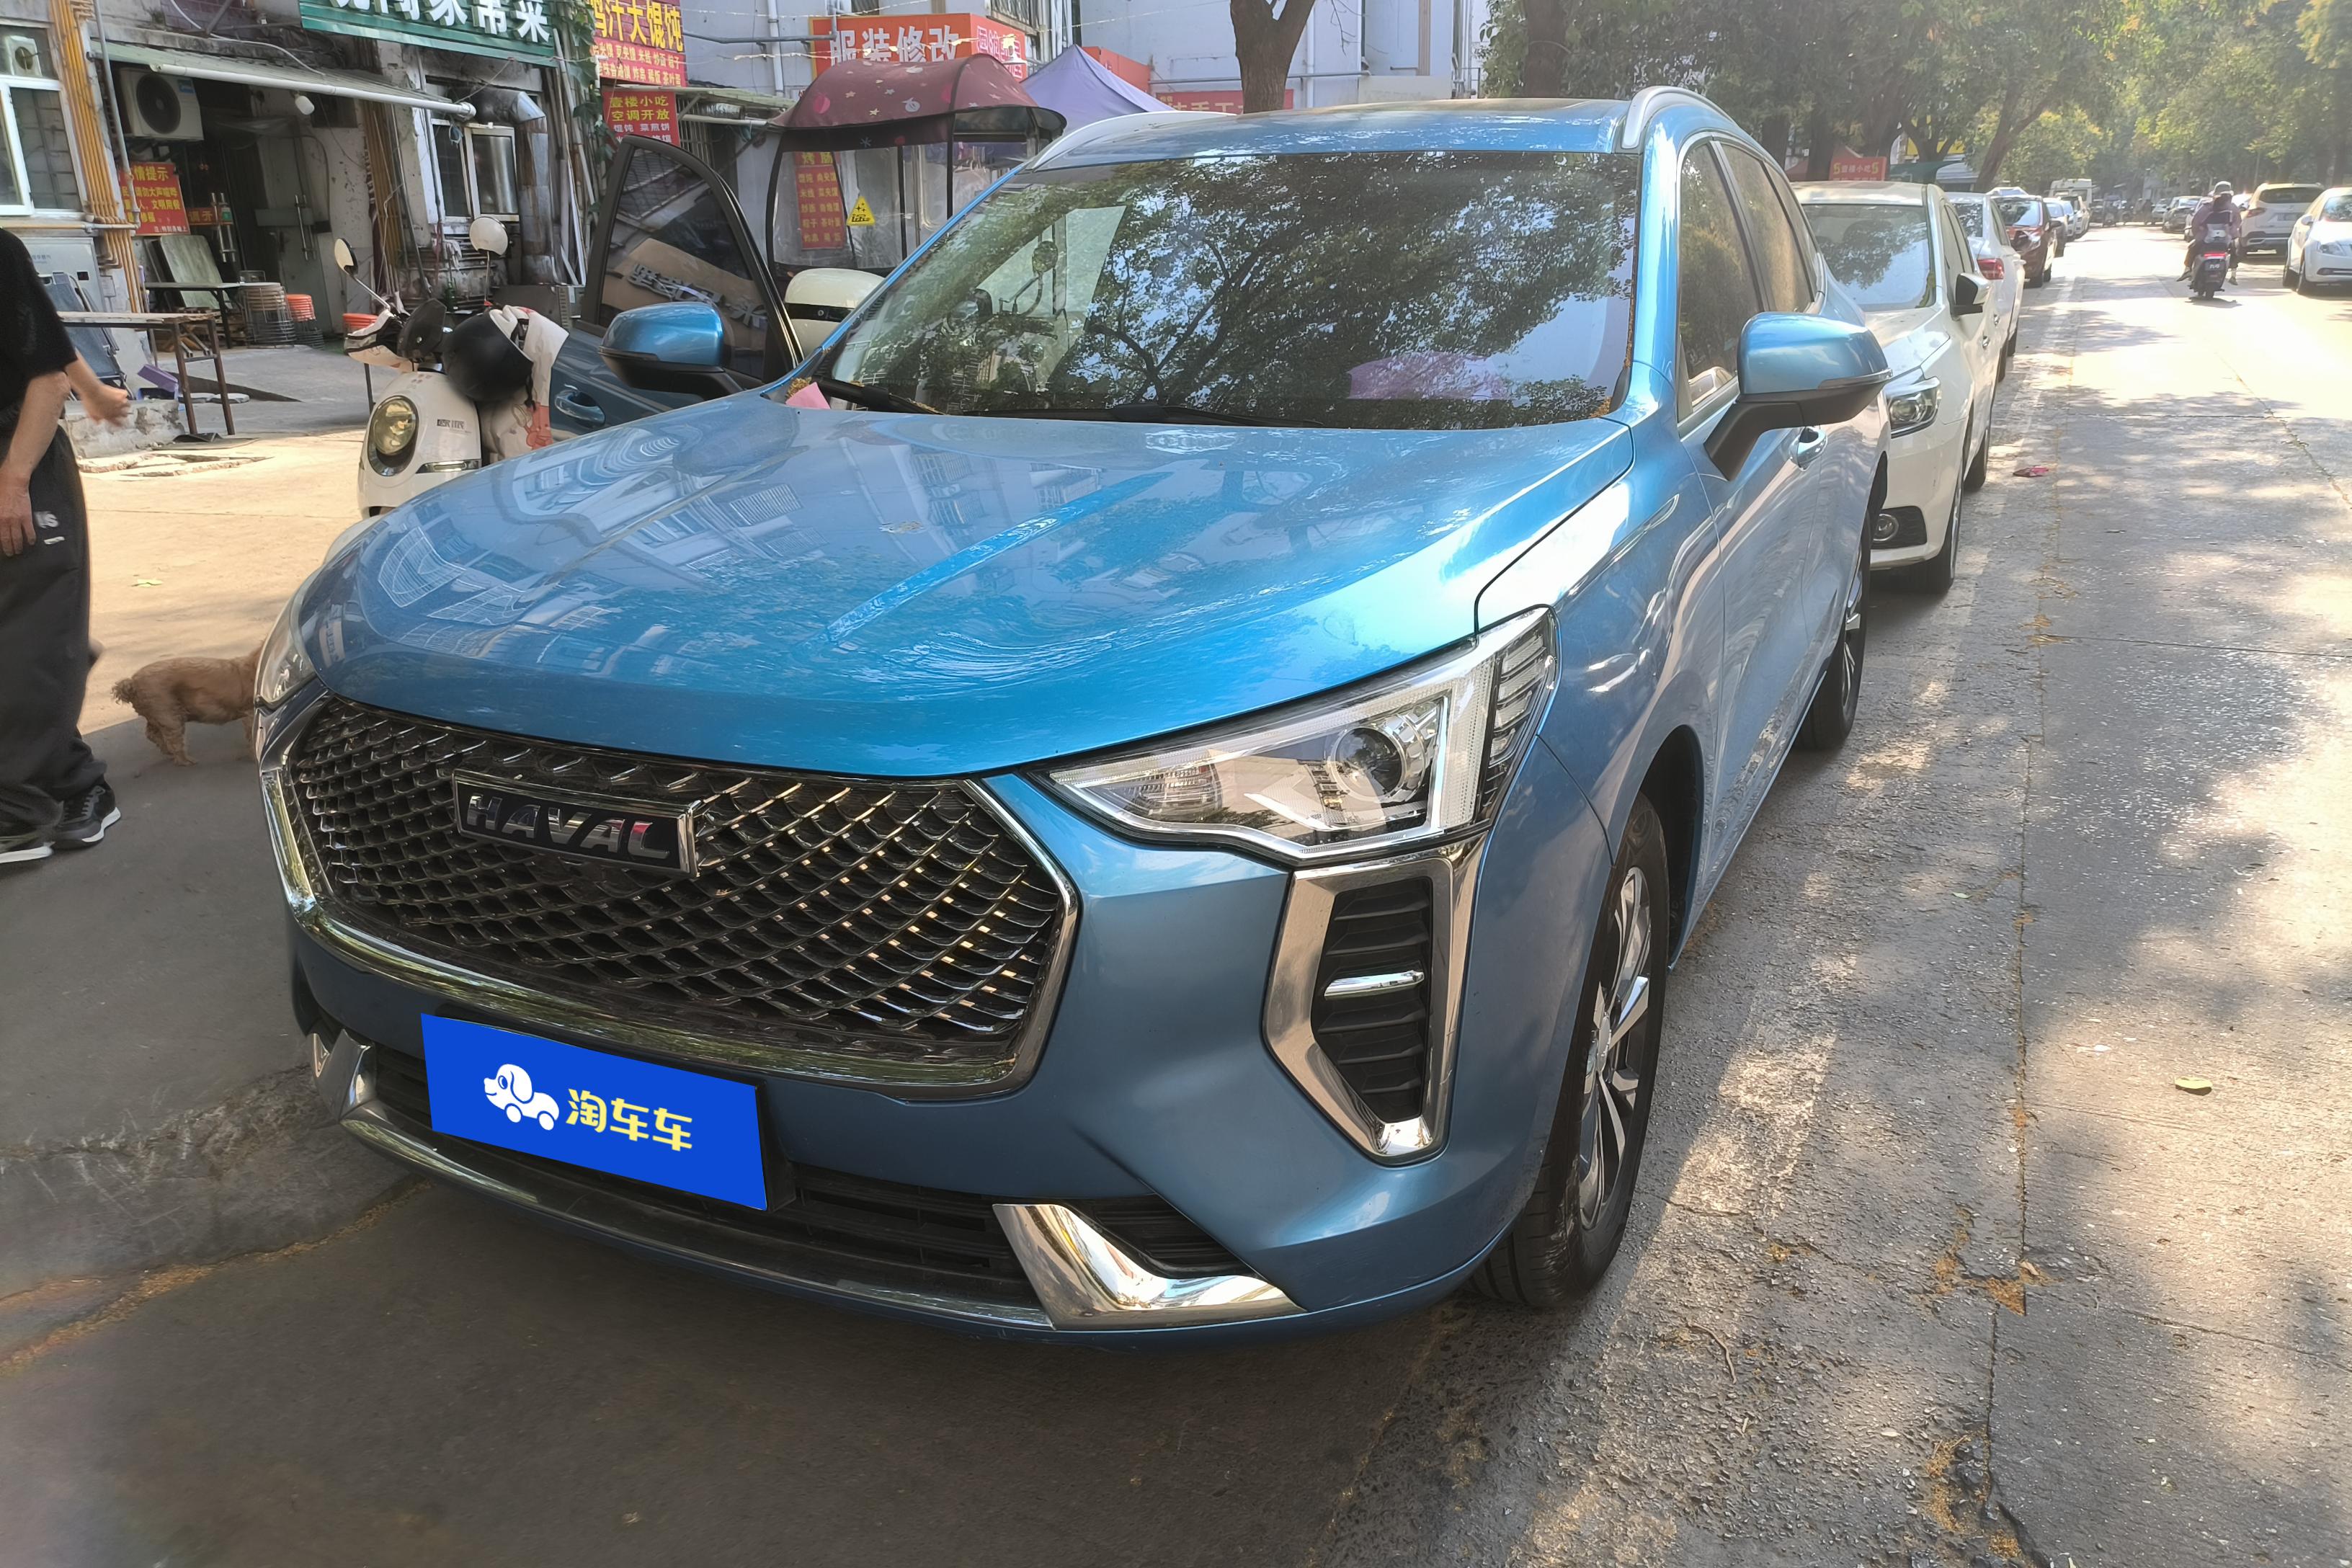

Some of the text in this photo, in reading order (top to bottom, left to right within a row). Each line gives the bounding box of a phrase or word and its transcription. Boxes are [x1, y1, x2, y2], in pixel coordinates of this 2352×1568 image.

[829, 25, 959, 66] 服装修改
[612, 109, 670, 121] 空调开放
[467, 794, 671, 859] HAVAL
